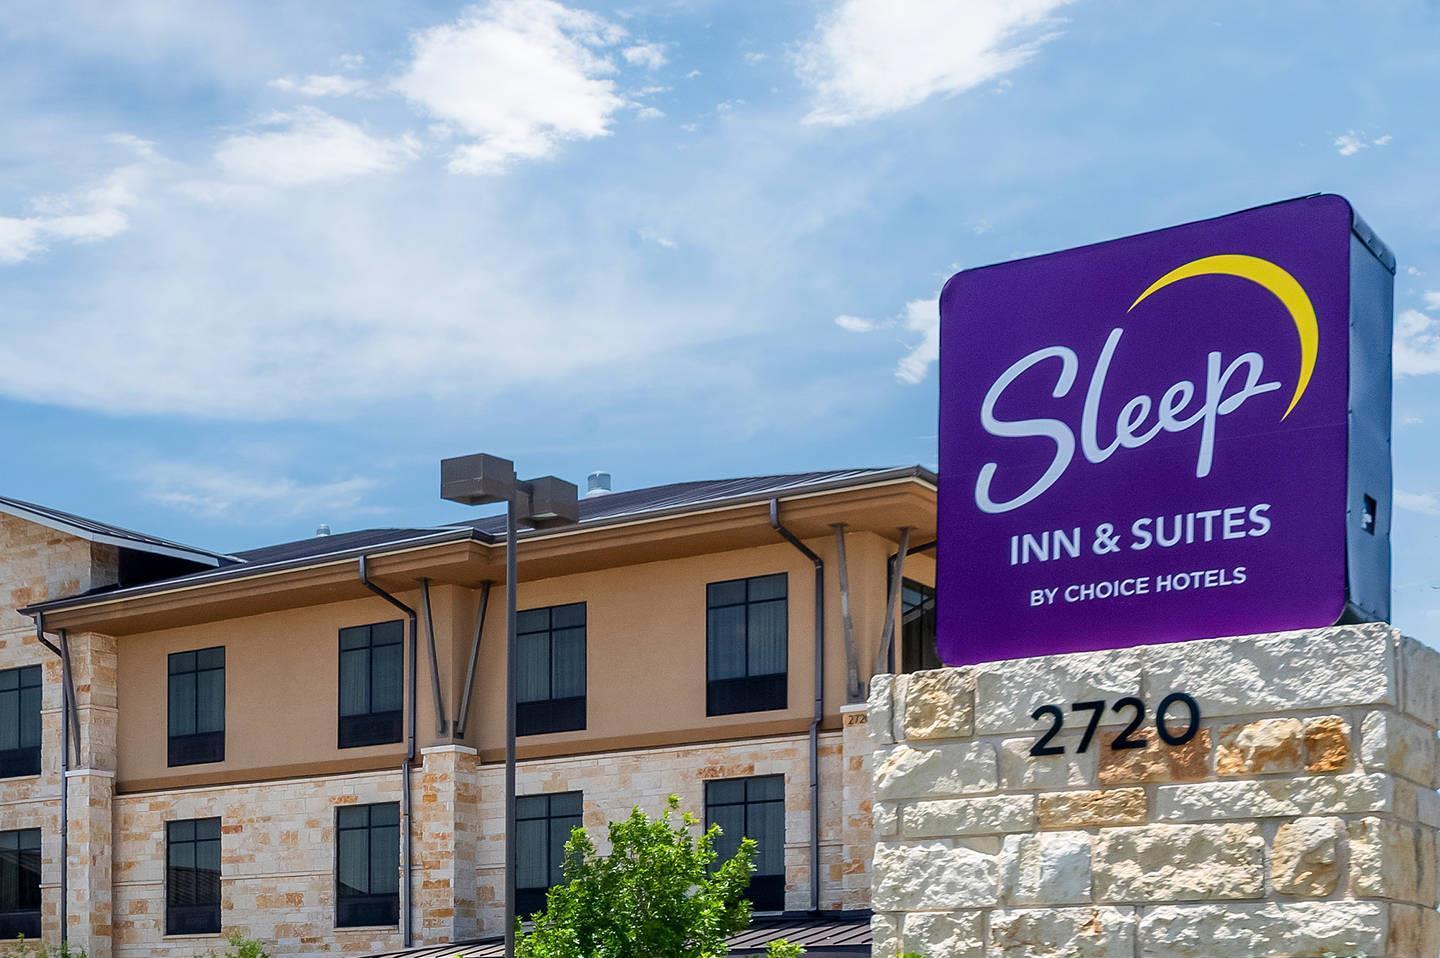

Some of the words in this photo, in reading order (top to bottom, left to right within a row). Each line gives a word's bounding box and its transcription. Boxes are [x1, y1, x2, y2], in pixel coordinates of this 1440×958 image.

[974, 327, 1282, 514] Sleep
[1010, 527, 1081, 566] INN
[1092, 522, 1121, 555] &
[1130, 503, 1272, 551] SUITES
[1030, 587, 1059, 607] BY
[1064, 576, 1150, 603] CHOICE
[1156, 566, 1247, 593] HOTELS
[1028, 692, 1201, 757] 2720
